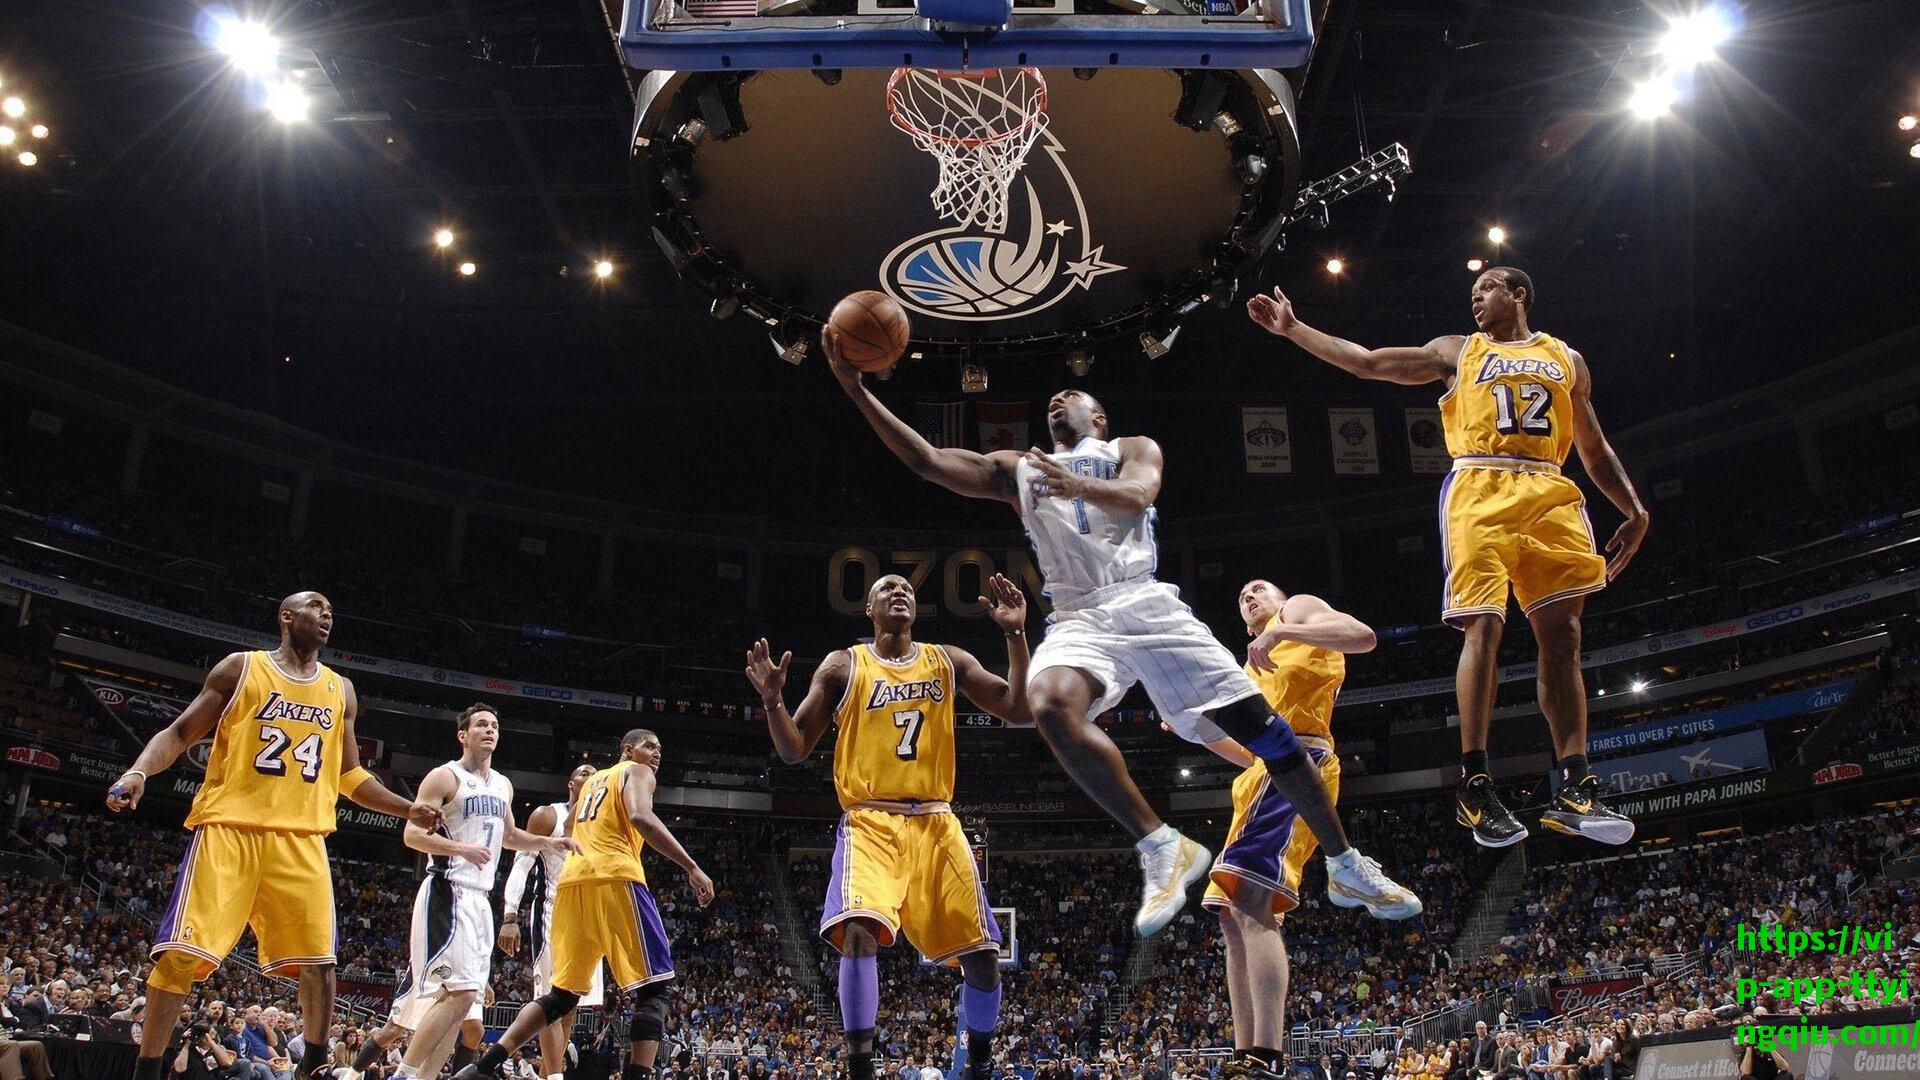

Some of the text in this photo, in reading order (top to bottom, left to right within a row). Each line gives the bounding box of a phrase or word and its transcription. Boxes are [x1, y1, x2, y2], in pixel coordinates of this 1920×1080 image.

[1212, 3, 1232, 12] NBA
[1475, 353, 1566, 385] LAKERS
[1491, 382, 1553, 438] 12
[1072, 498, 1090, 534] 1
[1746, 606, 1803, 630] GEICO
[1505, 664, 1537, 678] Amway
[521, 685, 573, 701] GEICO
[589, 697, 628, 709] PEPSICO
[866, 680, 945, 711] LAKERS
[254, 691, 333, 731] LAKERS
[966, 715, 992, 726] 4:52
[894, 709, 924, 761] 7
[1593, 735, 1622, 751] FARES
[1624, 733, 1637, 746] TO
[1638, 727, 1664, 744] OVER
[1681, 718, 1715, 736] CITIES
[70, 753, 96, 767] Better
[254, 724, 323, 784] 24
[1868, 750, 1895, 763] Better
[1884, 757, 1911, 769] Better
[81, 766, 107, 779] Better
[1610, 770, 1668, 794] Tran
[577, 786, 609, 823] 17
[1619, 800, 1645, 816] WIN
[1649, 794, 1681, 813] WITH
[1684, 786, 1717, 806] PAPA
[1720, 778, 1767, 799] JOHNS!
[355, 812, 400, 829] JOHNS!
[482, 822, 494, 848] 7
[1657, 1060, 1699, 1079] Connect
[1700, 1059, 1712, 1077] at
